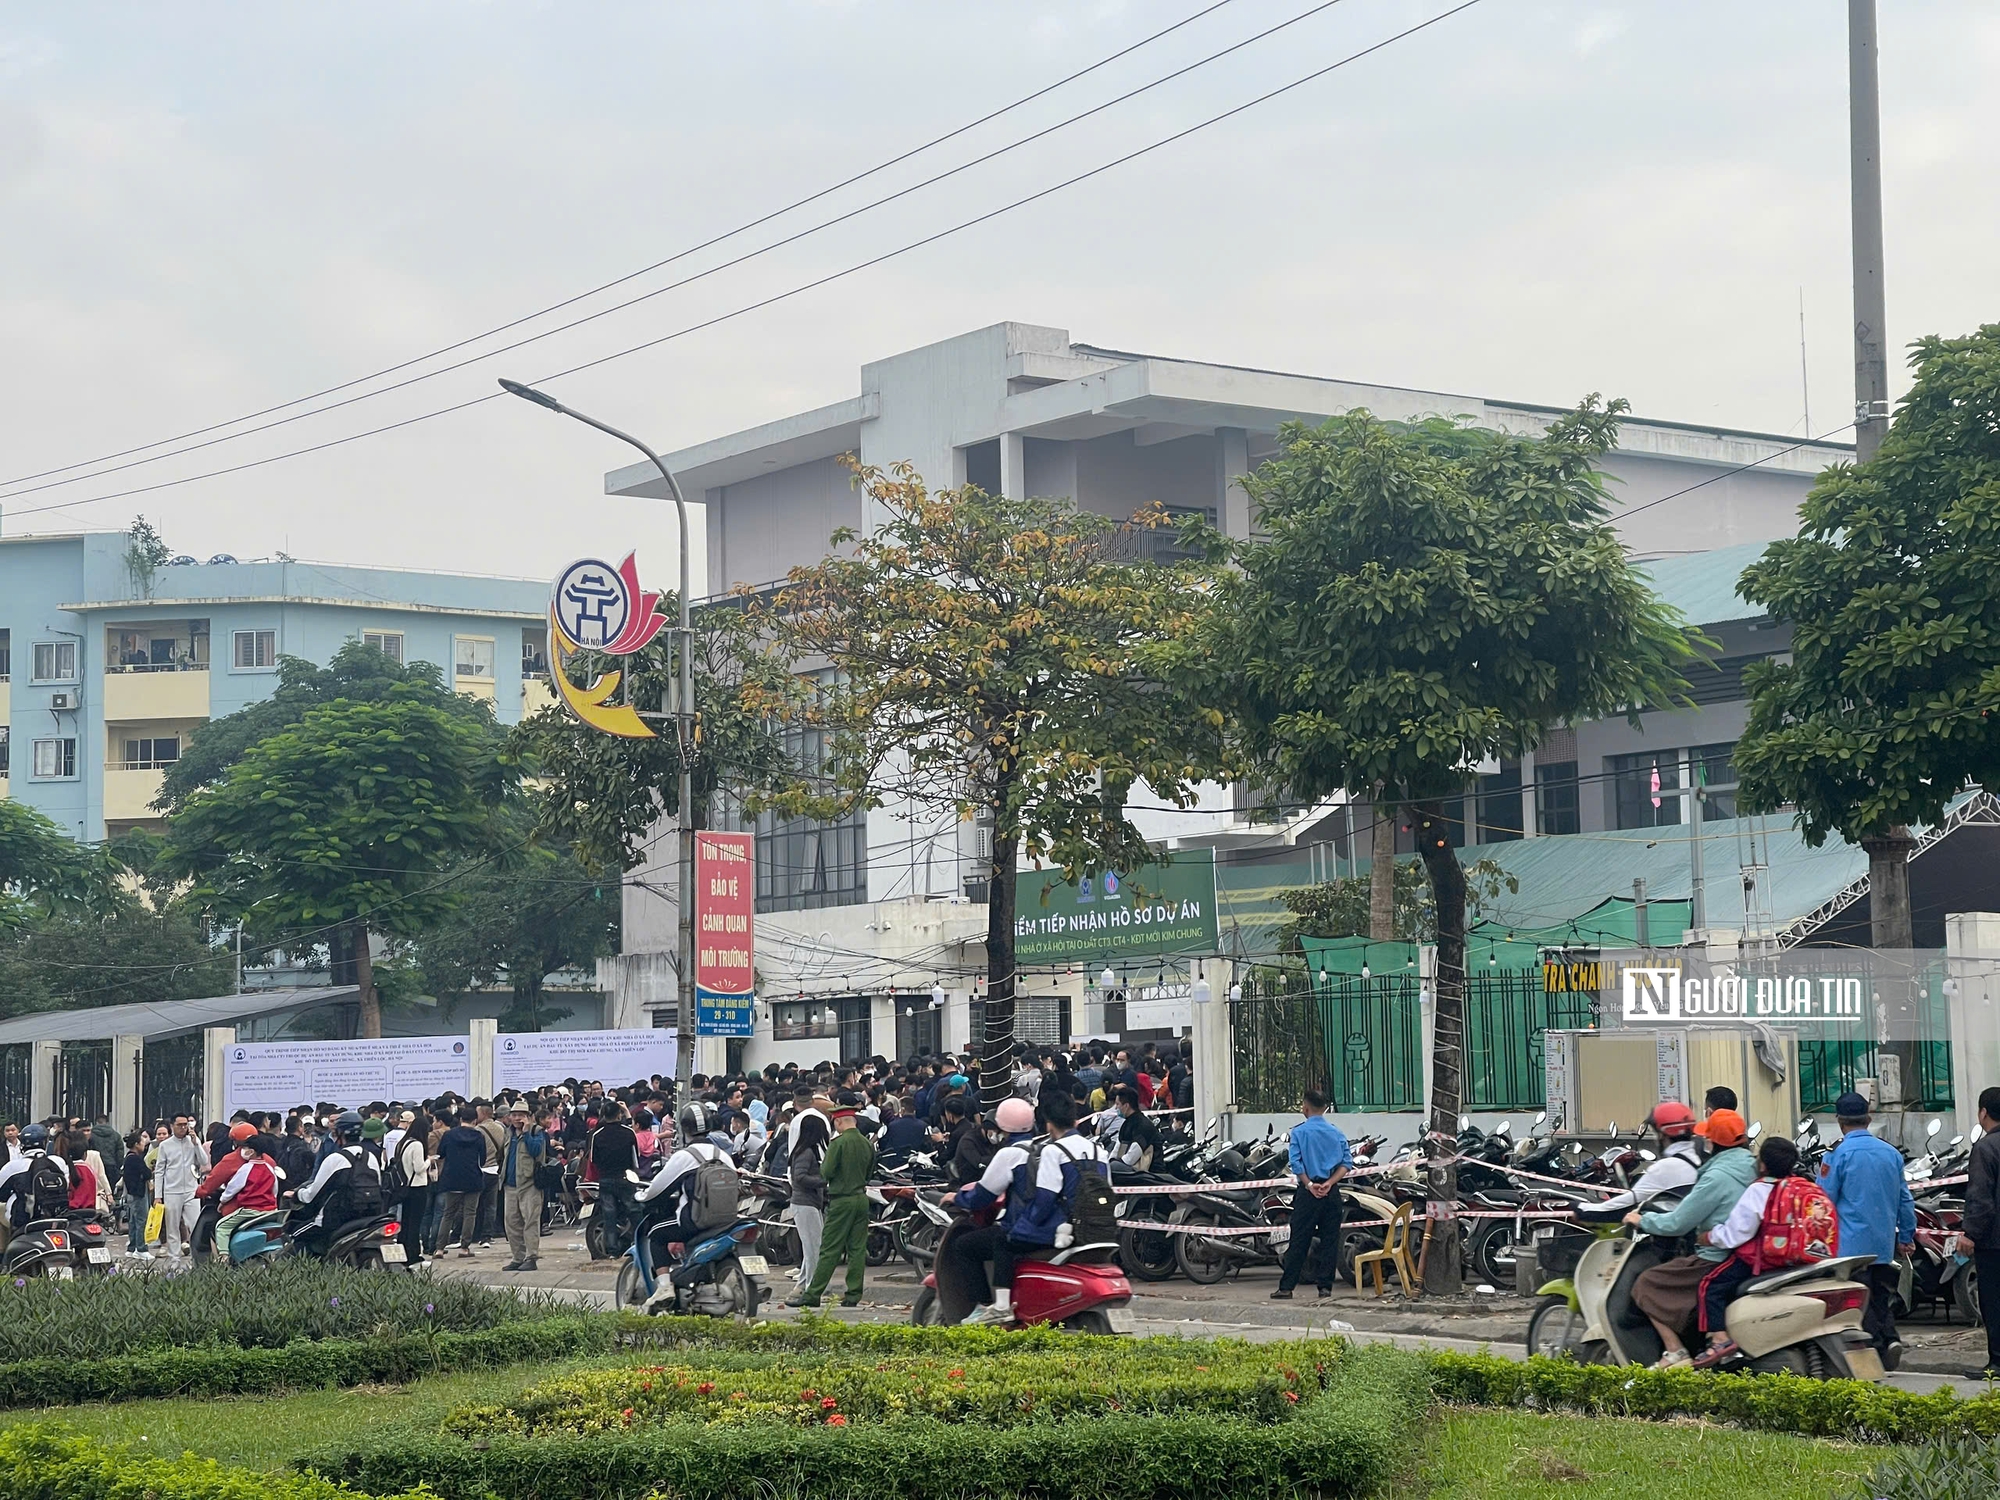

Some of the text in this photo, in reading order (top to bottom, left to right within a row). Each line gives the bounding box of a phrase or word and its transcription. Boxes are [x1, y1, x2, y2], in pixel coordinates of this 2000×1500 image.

[702, 842, 747, 866] TÔN TRỌNG,
[711, 871, 738, 901] BẢO VỆ
[702, 907, 747, 933] CẢNH QUAN
[1014, 899, 1200, 937] IỂM TIẾP NHẬN HỒ SƠ DỰ ÁN
[1113, 935, 1126, 946] CT4
[1161, 930, 1176, 941] KIM
[1176, 927, 1203, 940] CHUNG
[701, 946, 749, 969] MÔI TRƯỜNG
[1571, 961, 1616, 992] CHANH
[1588, 1003, 1609, 1015] Ngon
